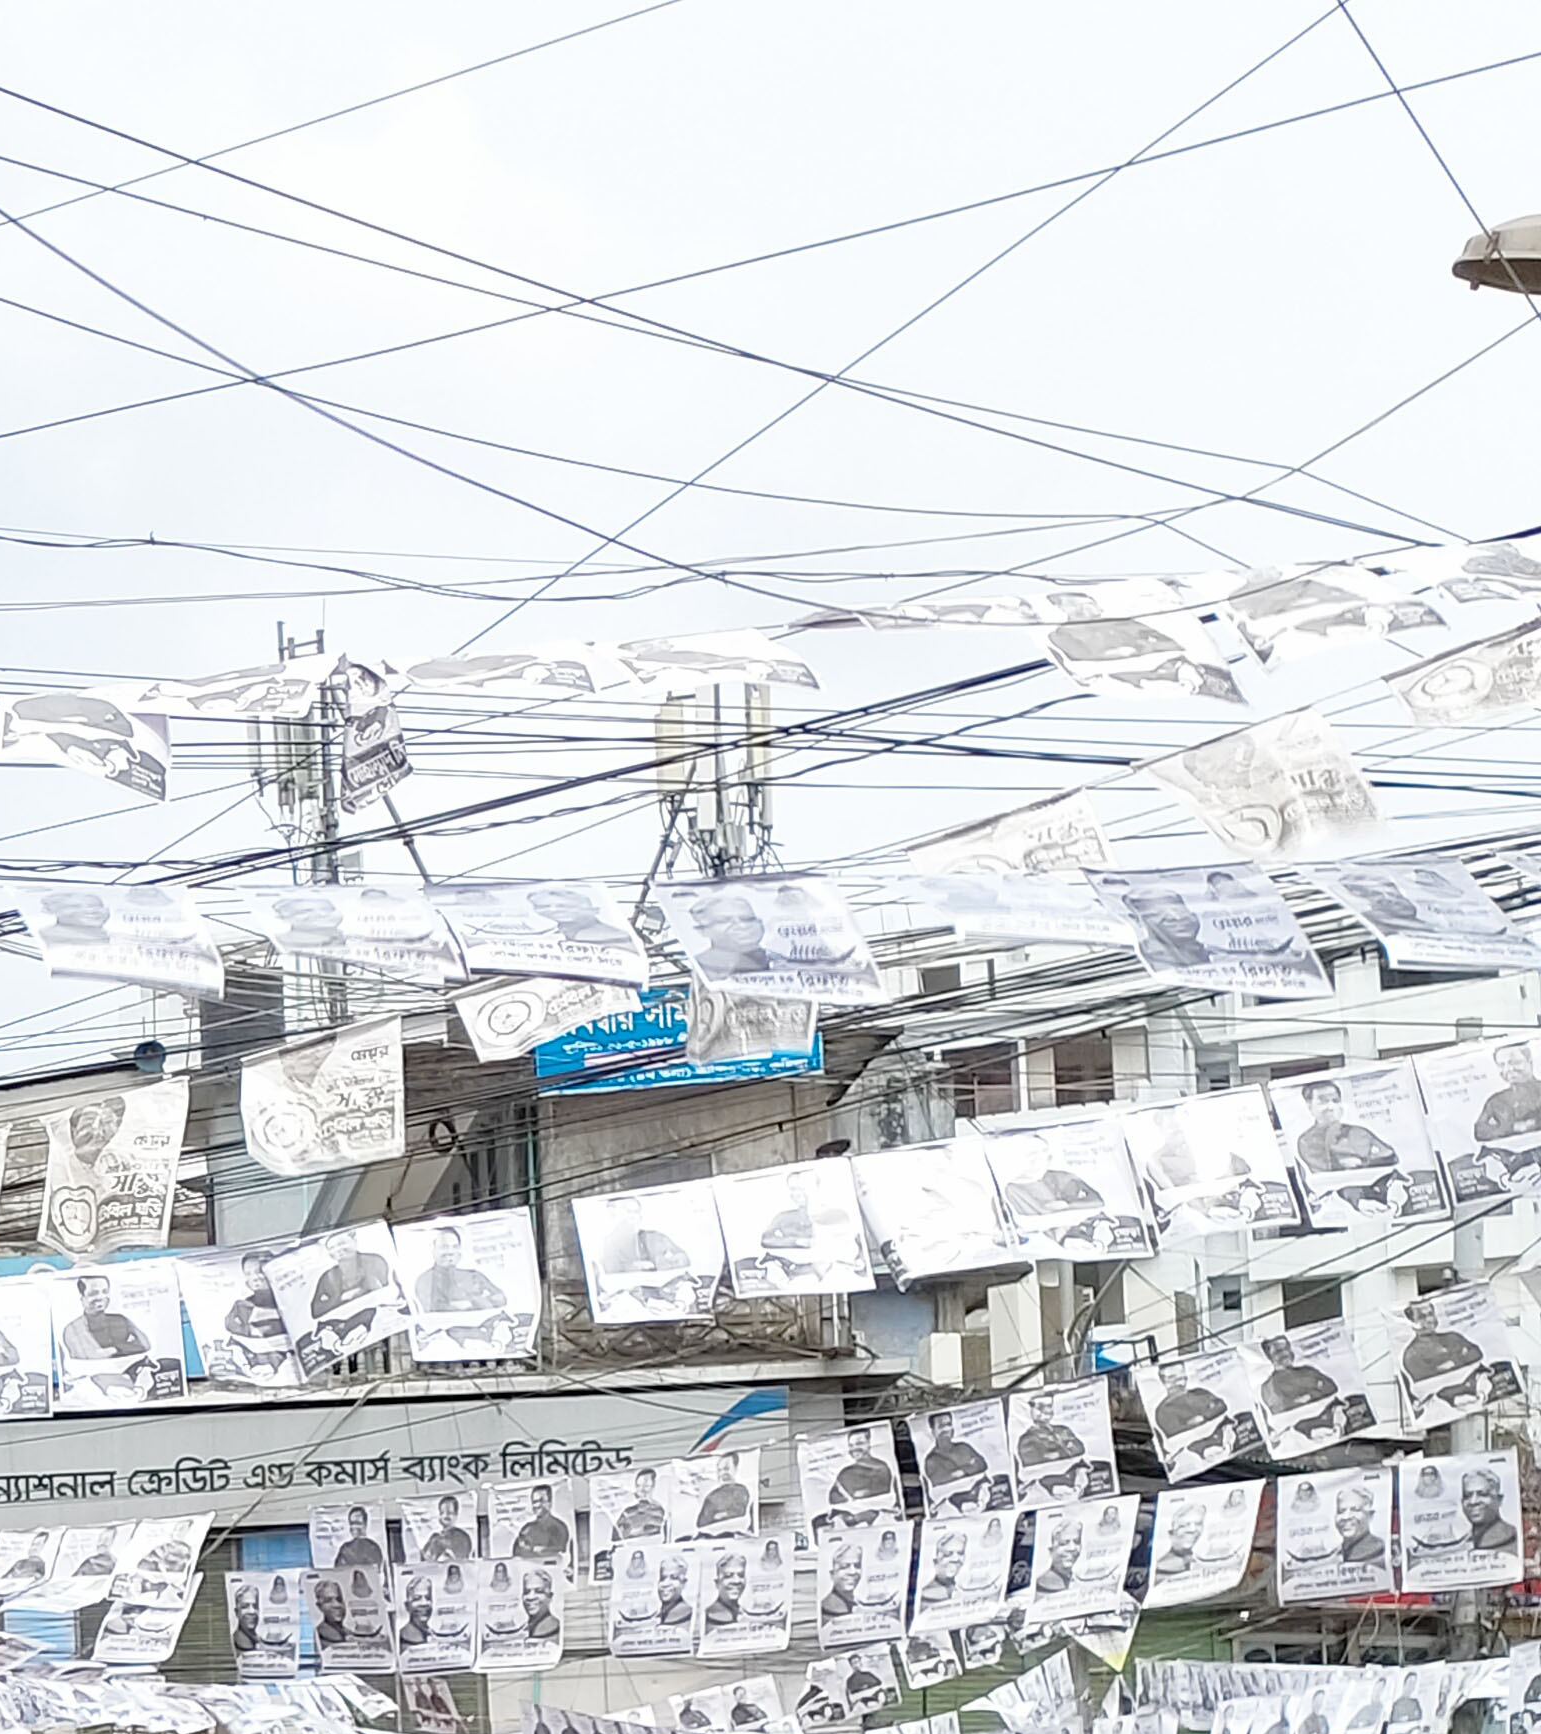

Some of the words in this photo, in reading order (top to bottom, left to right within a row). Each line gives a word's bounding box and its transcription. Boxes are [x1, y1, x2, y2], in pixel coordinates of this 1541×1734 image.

[128, 1456, 232, 1498] ক্রেডিট
[305, 1448, 391, 1488] কমার্স
[400, 1451, 490, 1487] ব্যাংক
[500, 1440, 634, 1480] লিমিটেড
